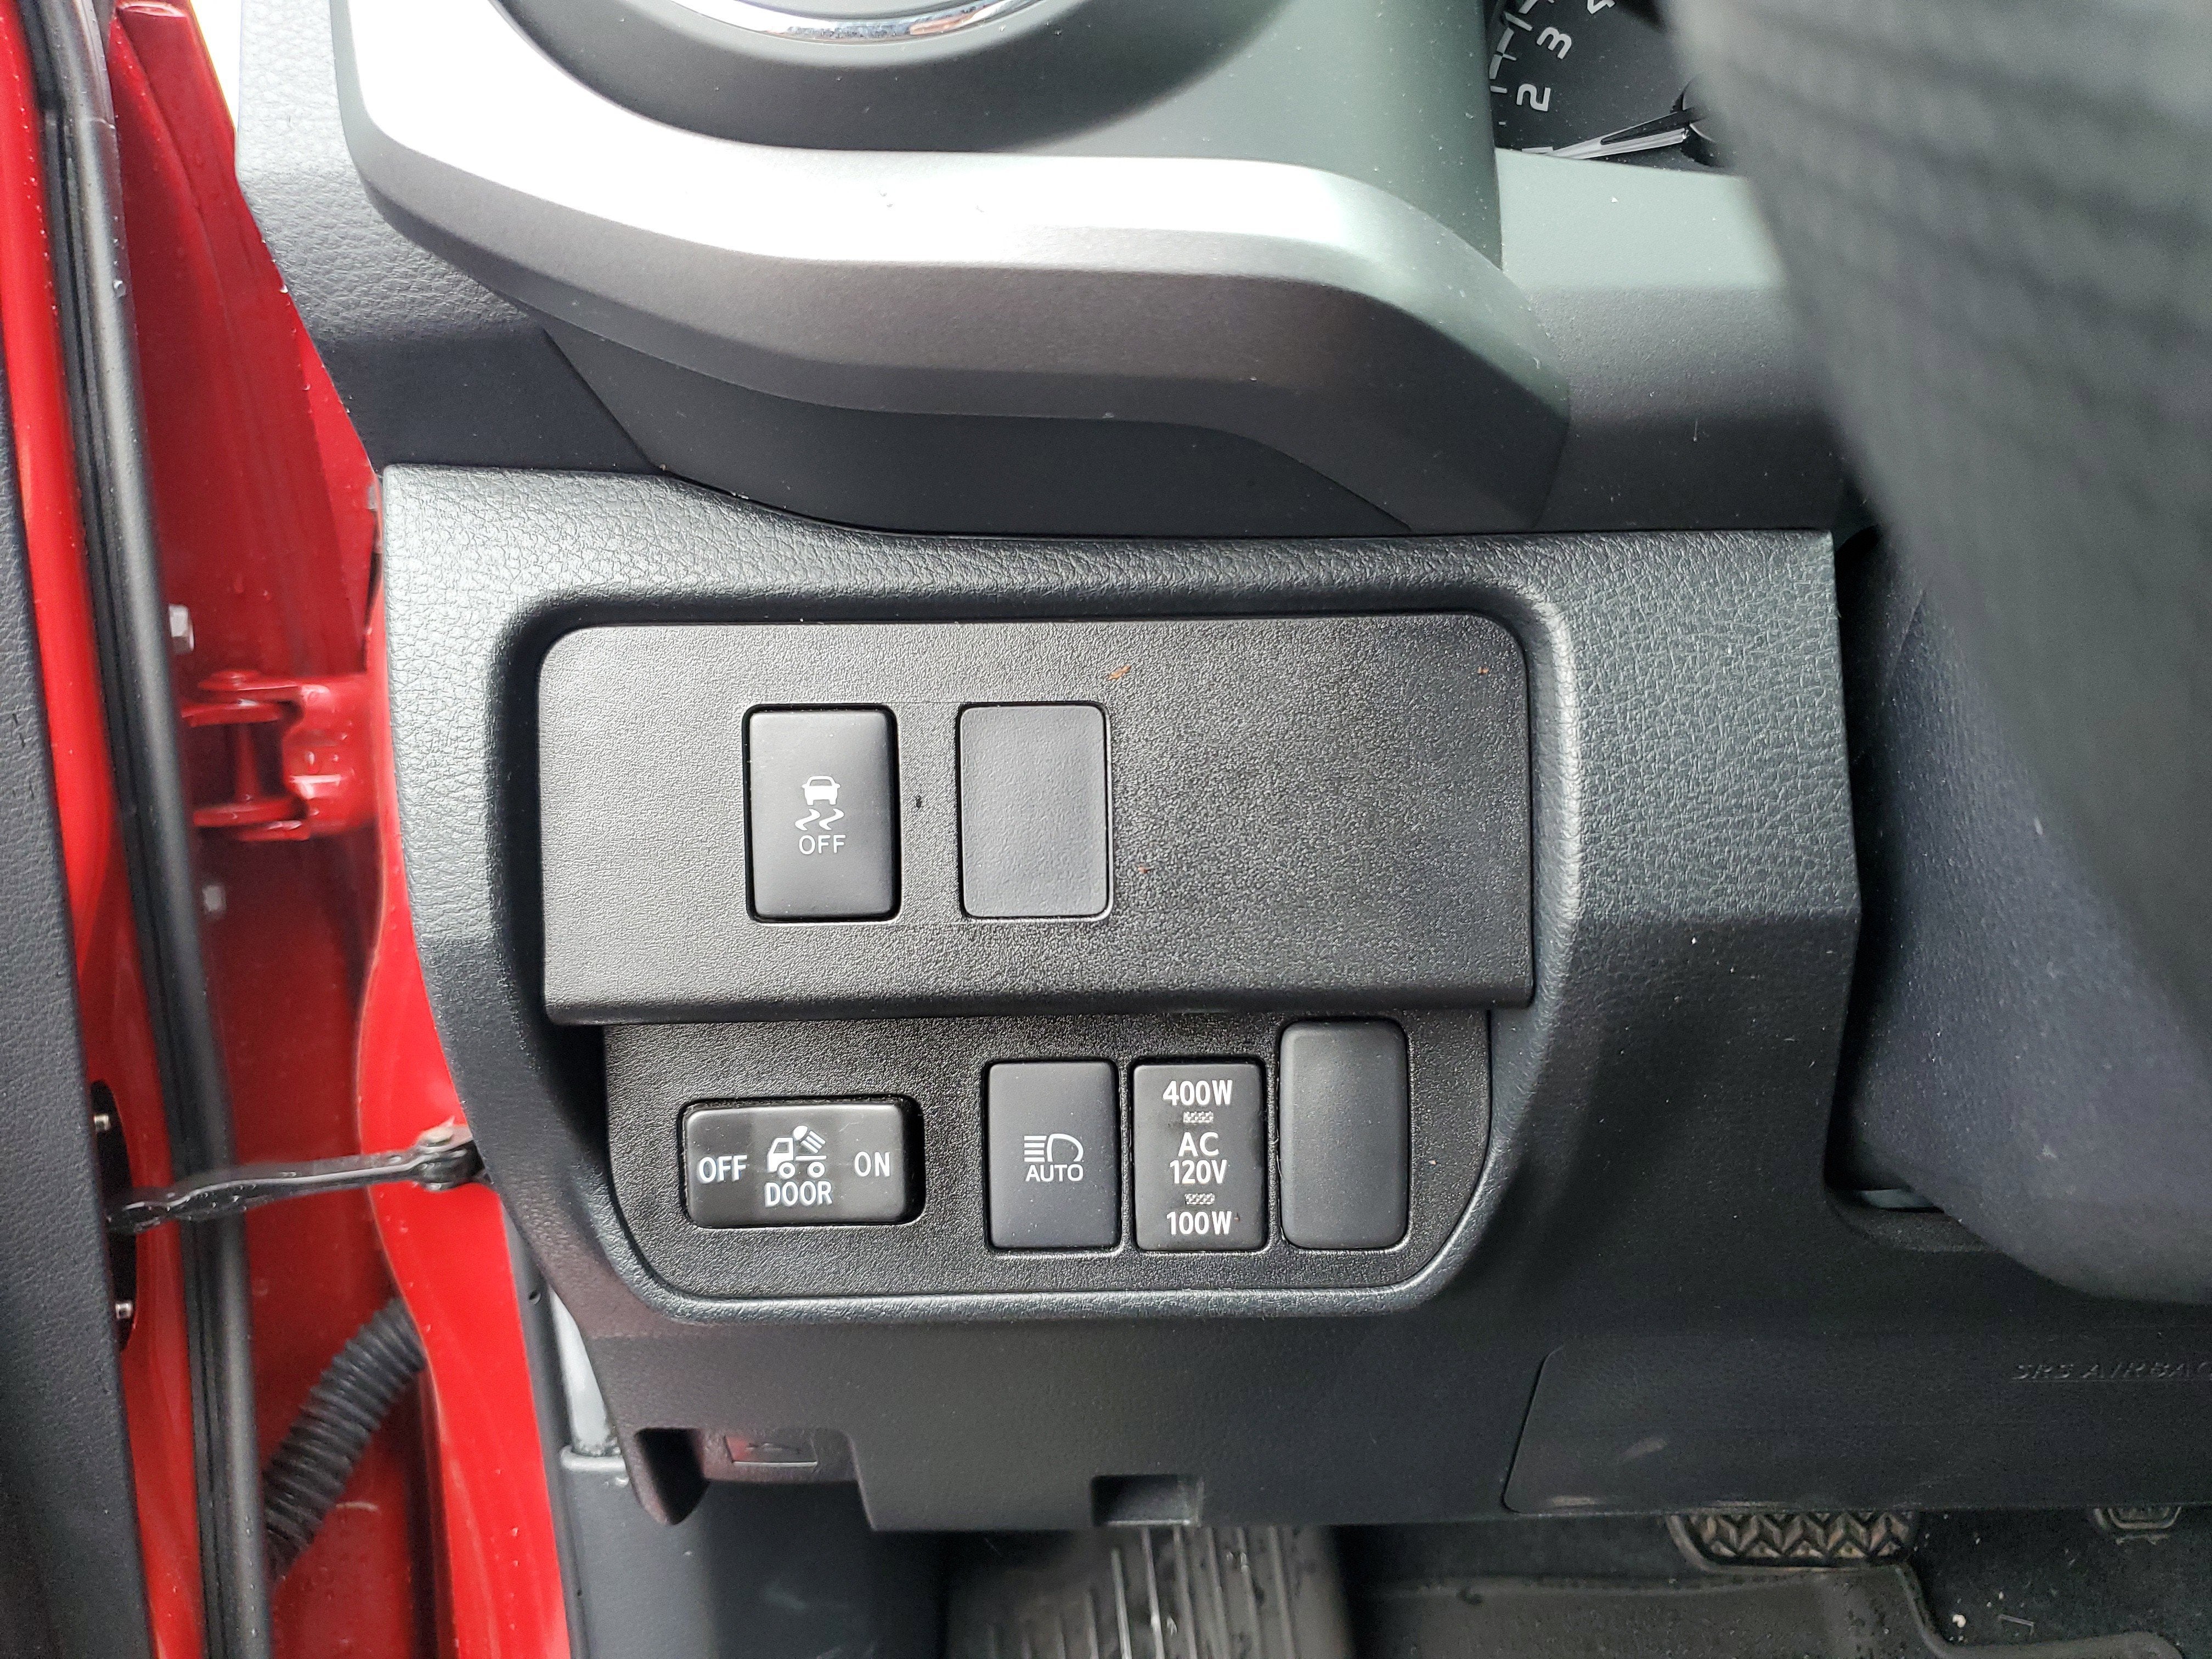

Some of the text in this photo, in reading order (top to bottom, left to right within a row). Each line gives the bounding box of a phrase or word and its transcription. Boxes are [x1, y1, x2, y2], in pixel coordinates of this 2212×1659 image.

[1536, 26, 1572, 59] 3
[1516, 83, 1551, 112] 2
[799, 834, 847, 855] OFF
[1162, 1080, 1233, 1106] 400W
[1178, 1132, 1220, 1157] AC
[698, 1155, 748, 1183] OFF
[855, 1151, 890, 1177] ON
[1025, 1164, 1084, 1182] AUTO
[1170, 1160, 1227, 1184] 120V
[765, 1181, 832, 1206] DOOR
[1166, 1211, 1232, 1235] 100W
[2012, 1363, 2074, 1379] SRS
